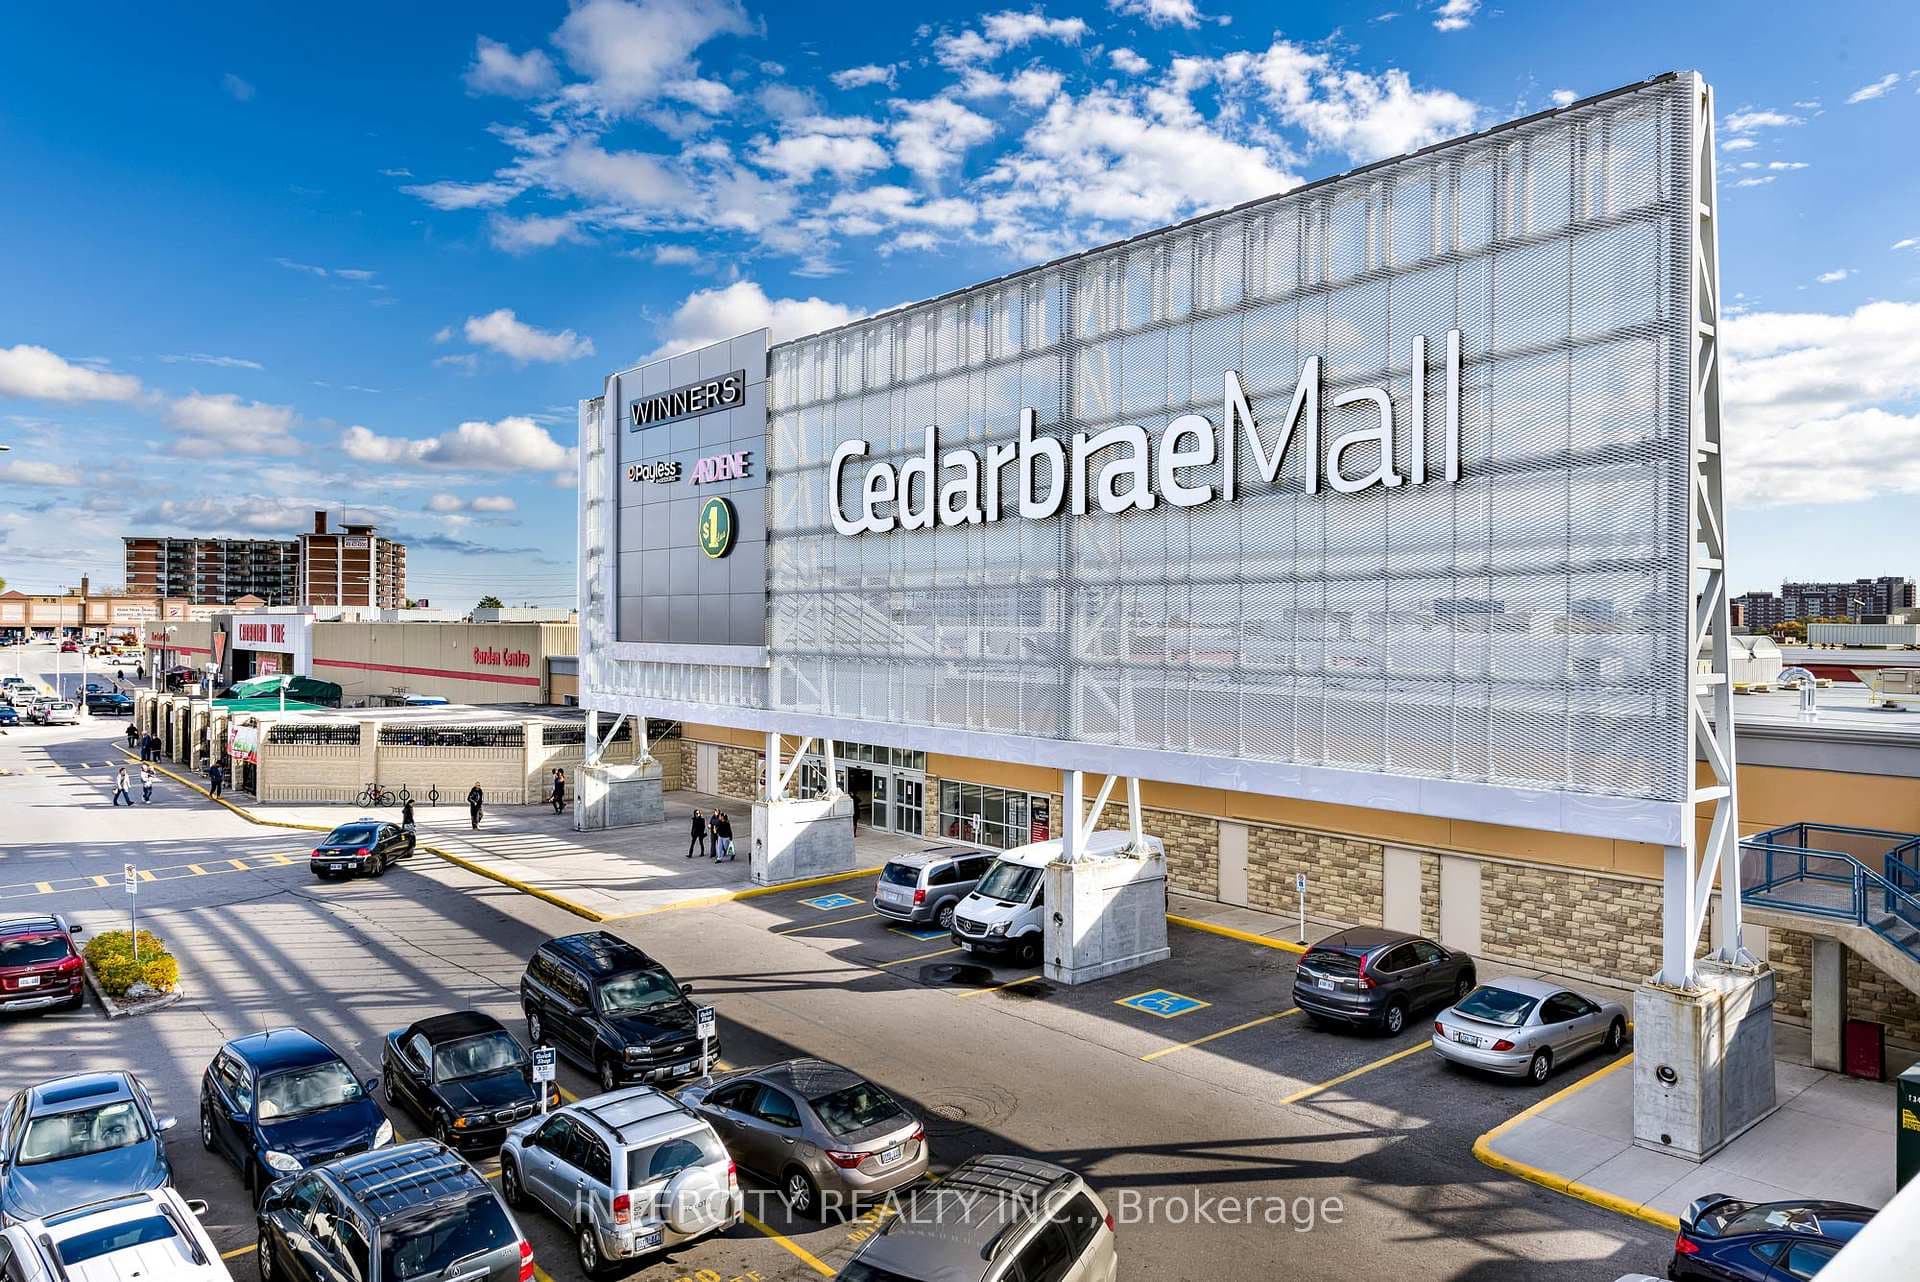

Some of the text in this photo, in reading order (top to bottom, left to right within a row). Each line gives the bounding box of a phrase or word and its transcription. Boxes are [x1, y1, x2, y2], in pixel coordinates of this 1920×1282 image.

[631, 376, 737, 425] WINNERS
[636, 461, 677, 483] Payless
[687, 451, 749, 486] ARDENE
[239, 623, 285, 643] CANADIAN TIRE
[473, 647, 531, 667] Garden Centre
